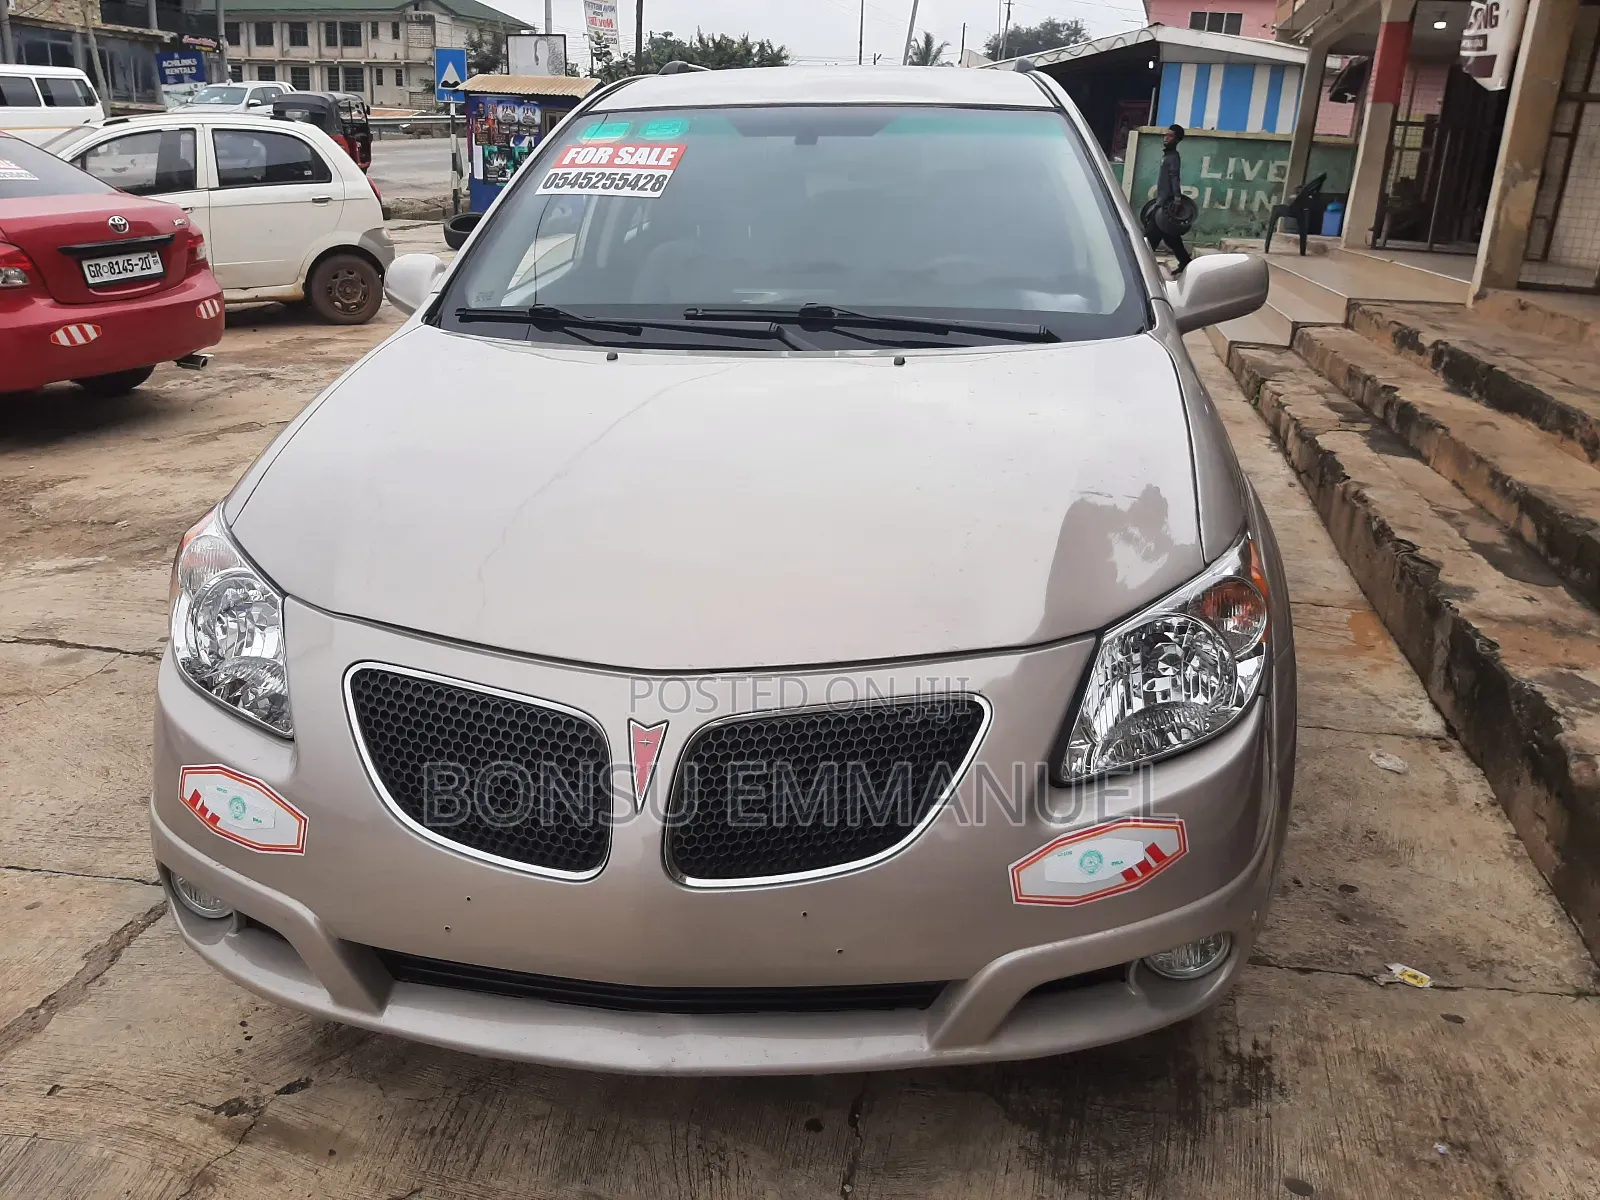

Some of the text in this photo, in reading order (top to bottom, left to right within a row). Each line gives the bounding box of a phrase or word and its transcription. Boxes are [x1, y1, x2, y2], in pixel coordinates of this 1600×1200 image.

[165, 67, 197, 75] RENTALS
[562, 147, 679, 166] FOR SALE
[1201, 156, 1289, 183] LIVE
[542, 171, 668, 193] 0545255428
[87, 263, 103, 278] GR
